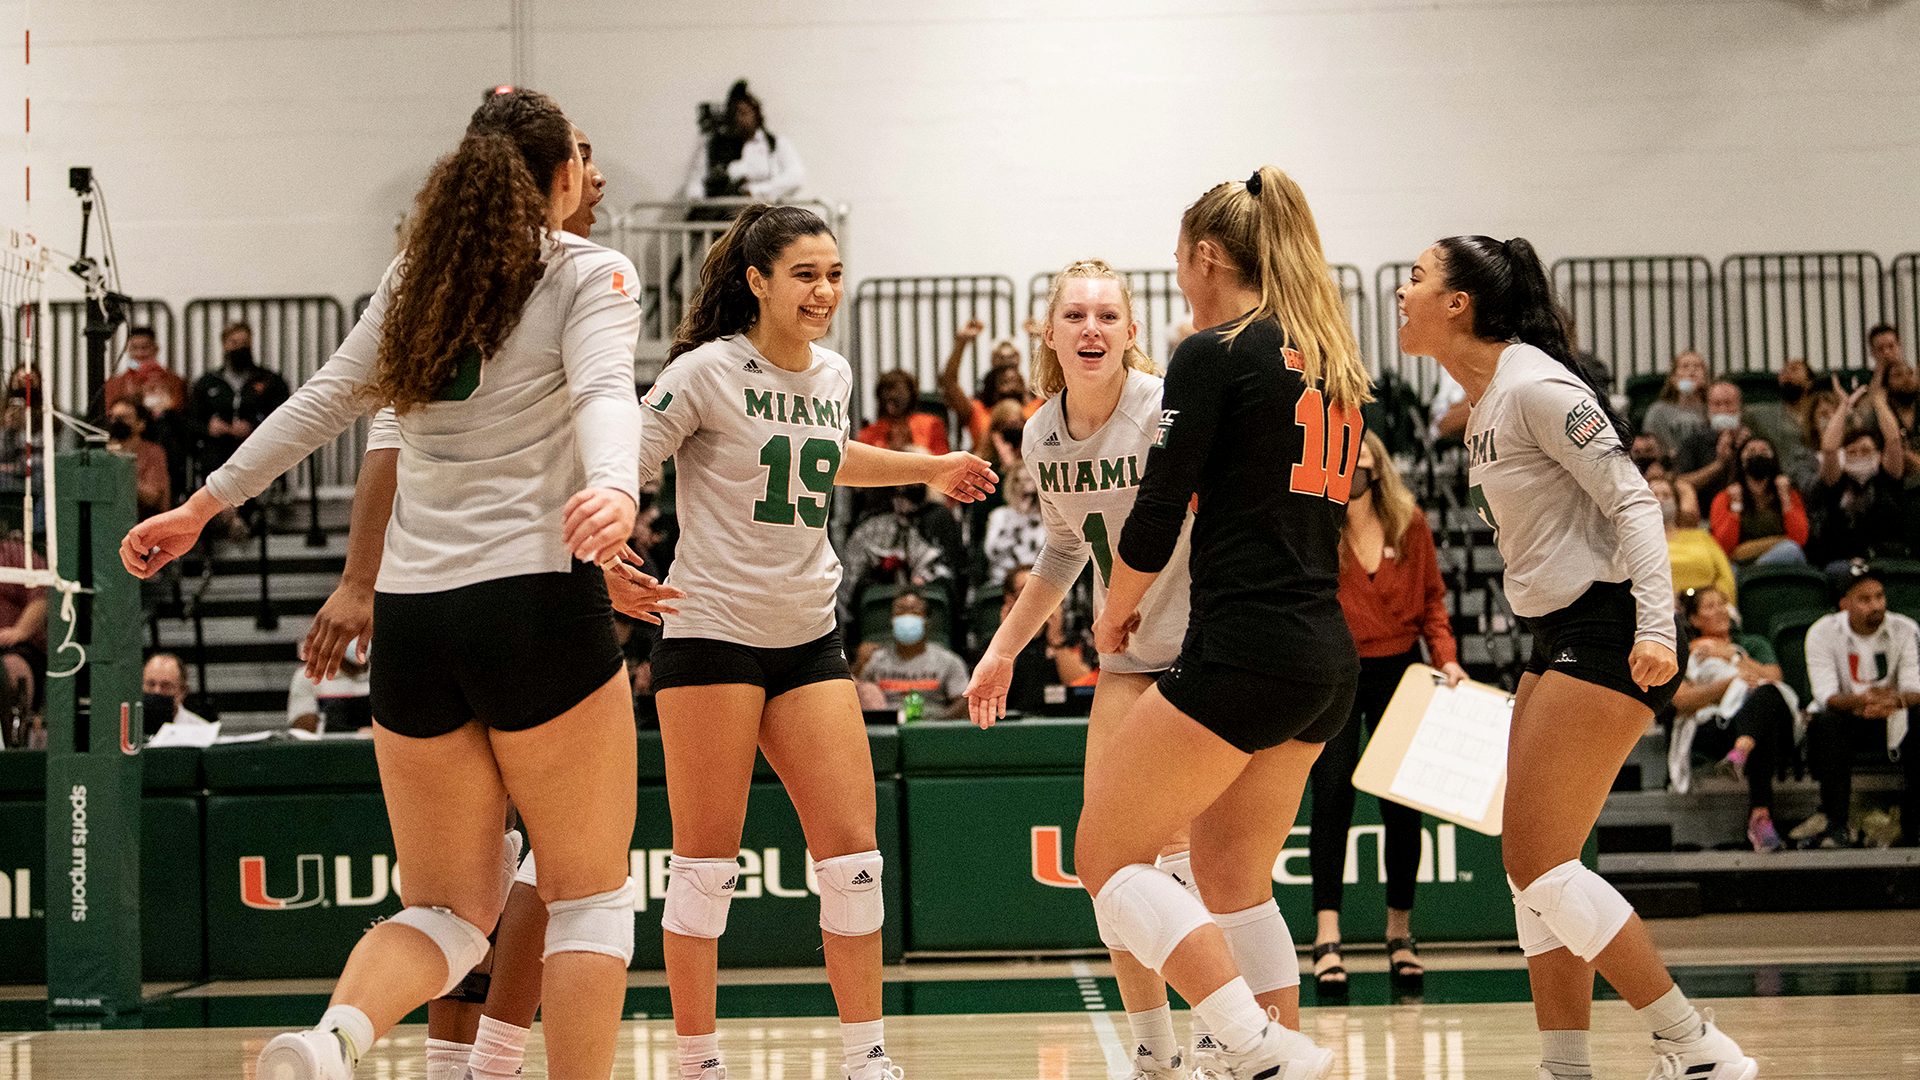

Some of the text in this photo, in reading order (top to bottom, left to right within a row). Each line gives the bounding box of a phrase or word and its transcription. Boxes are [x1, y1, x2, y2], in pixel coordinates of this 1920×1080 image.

[743, 387, 844, 432] MIAMI
[1565, 399, 1593, 430] ACC
[1570, 411, 1607, 446] UNITE
[1289, 386, 1365, 506] 10
[751, 433, 842, 530] 19
[1036, 453, 1142, 495] MIAMI
[69, 785, 89, 922] sports imports
